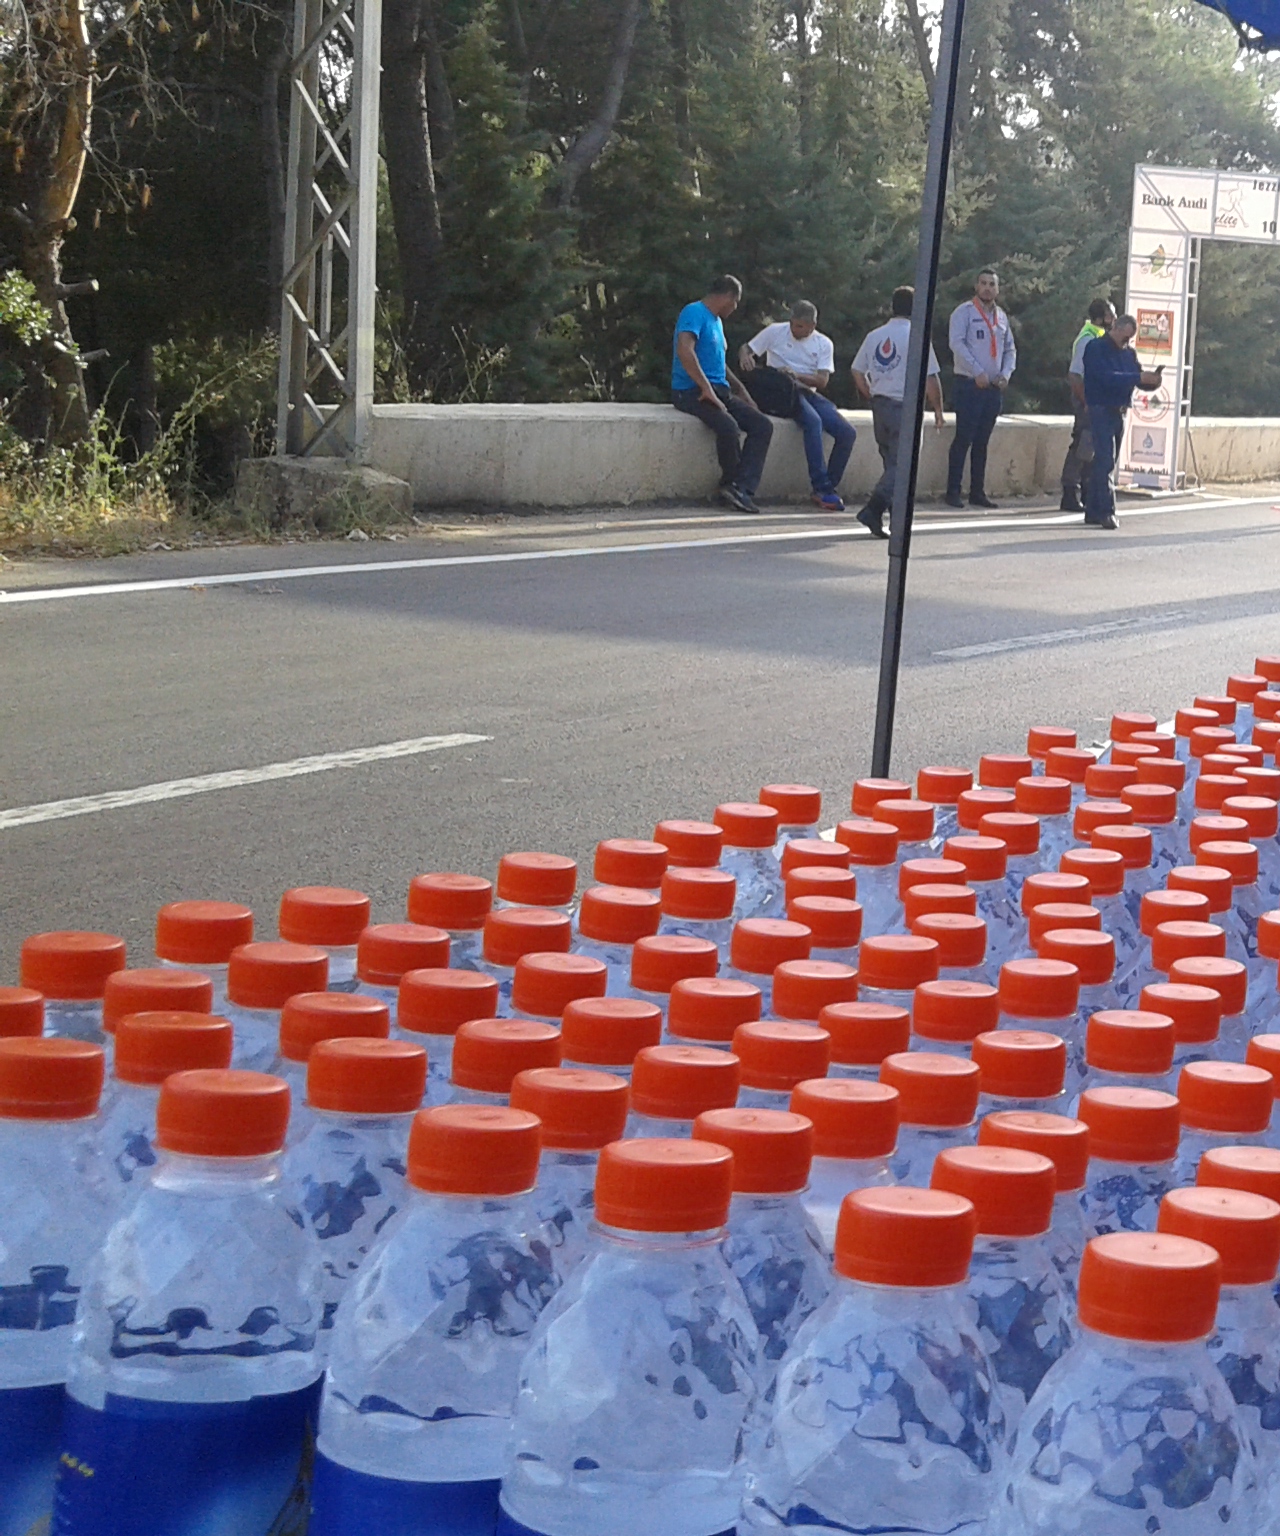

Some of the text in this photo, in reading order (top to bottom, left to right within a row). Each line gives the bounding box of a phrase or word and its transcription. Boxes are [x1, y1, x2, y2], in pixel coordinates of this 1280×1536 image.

[1142, 193, 1208, 210] Bank Audi
[1262, 220, 1277, 235] 10
